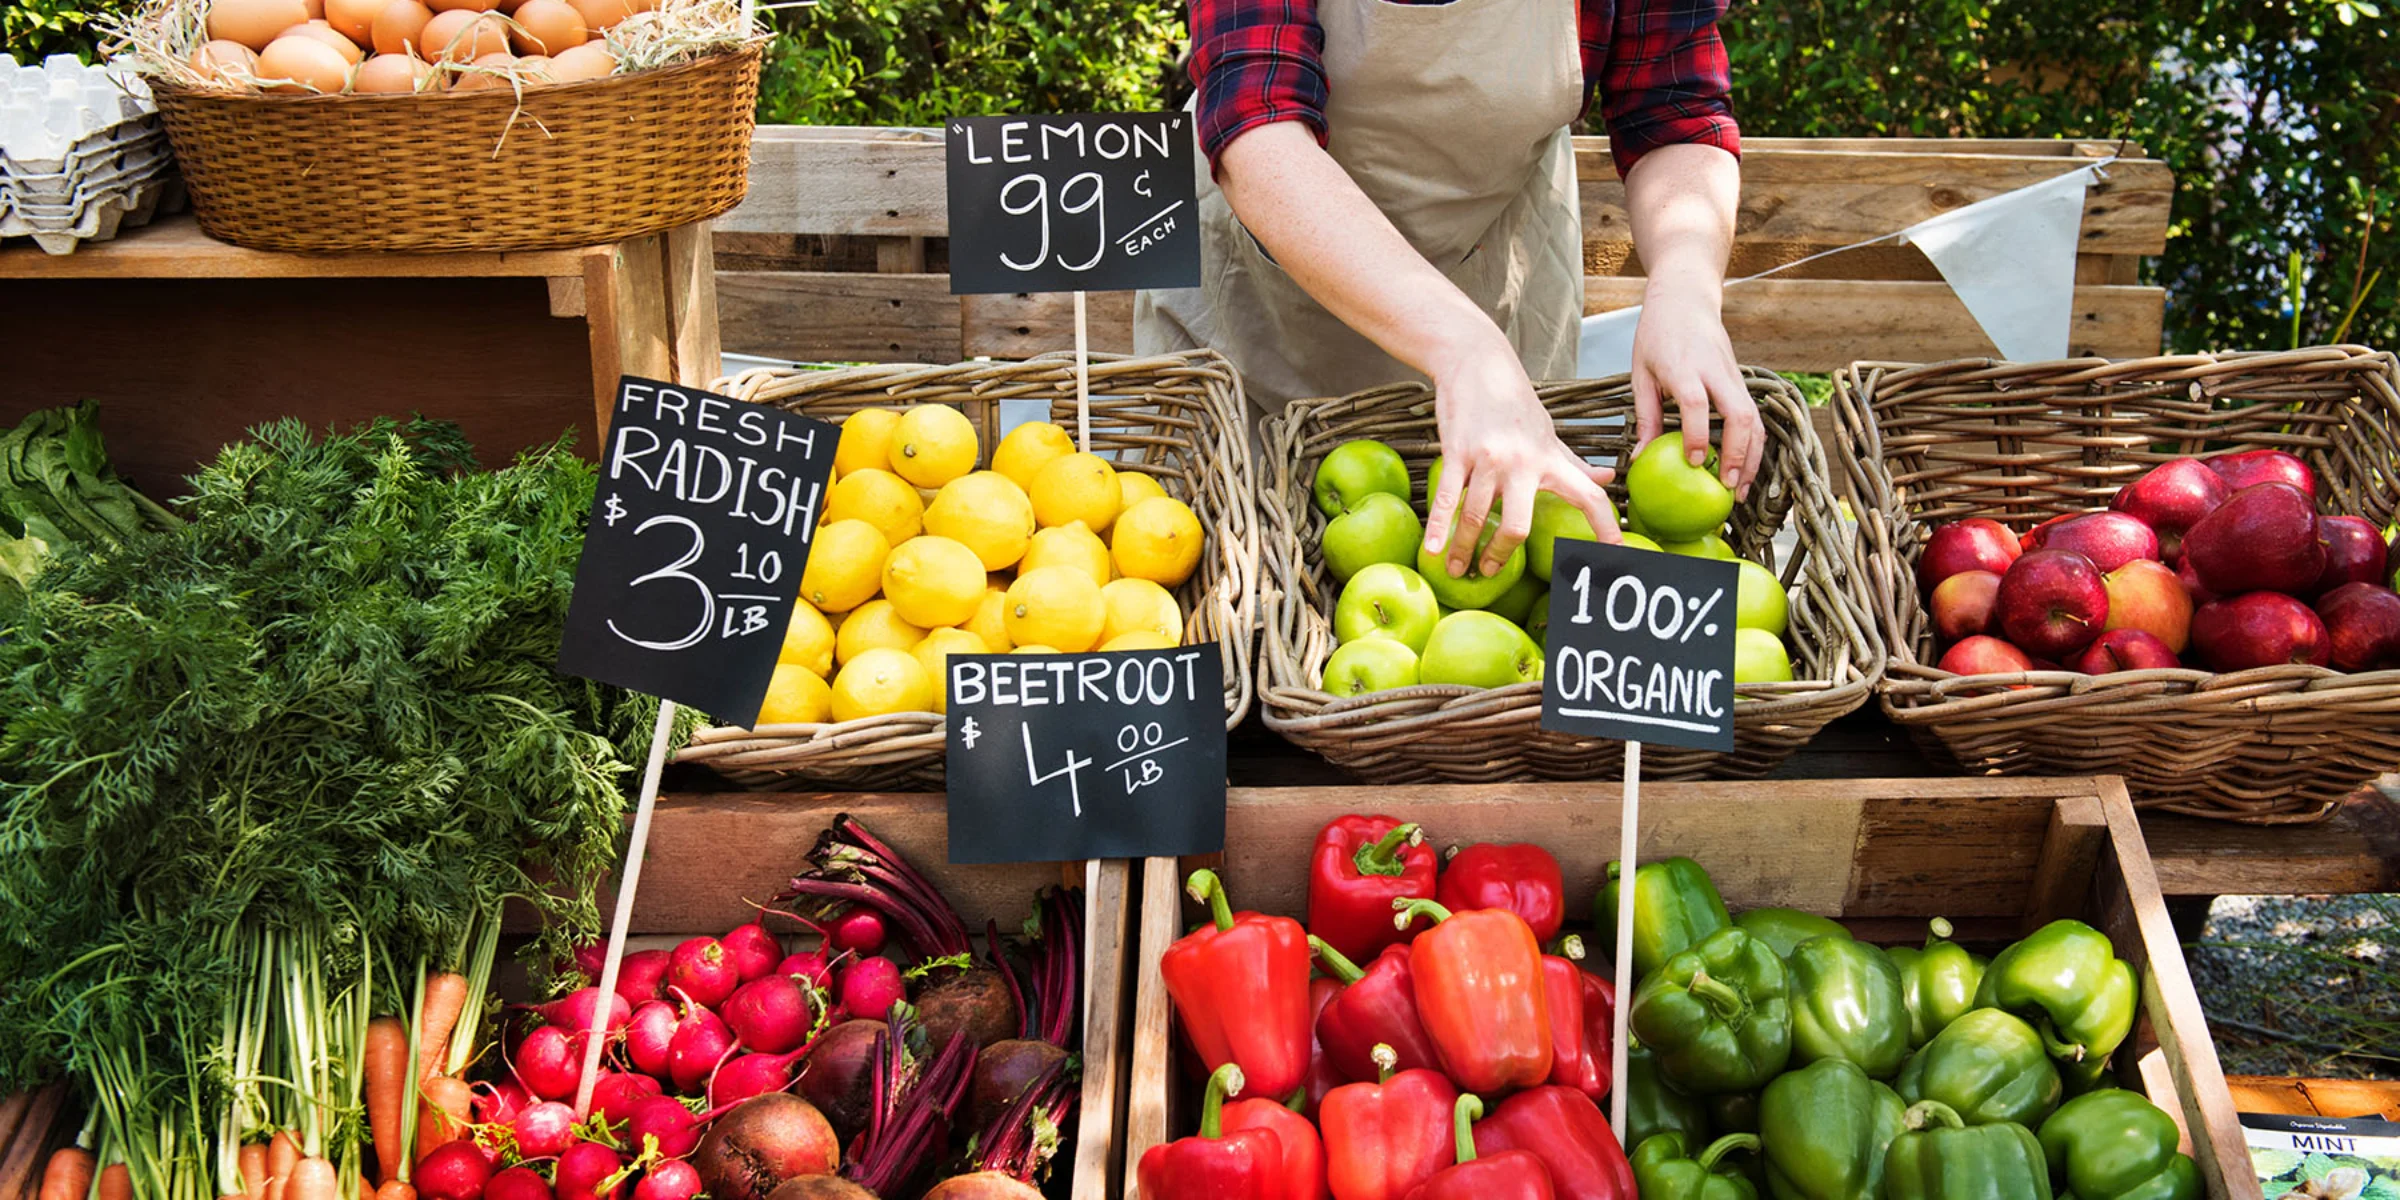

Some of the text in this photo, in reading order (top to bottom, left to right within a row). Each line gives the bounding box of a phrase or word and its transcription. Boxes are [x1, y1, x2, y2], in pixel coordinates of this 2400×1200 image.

[999, 172, 1106, 272] 99
[1125, 216, 1177, 257] EACH
[621, 383, 815, 460] FRESH
[610, 426, 820, 544] RADISH
[730, 542, 783, 584] 10
[722, 605, 769, 639] LB
[1570, 565, 1724, 644] 100%
[952, 652, 1201, 707] BEETROOT
[1555, 645, 1725, 719] ORGANIC
[1117, 723, 1164, 753] 00
[1124, 759, 1165, 795] LB
[2291, 1134, 2358, 1152] MINT
